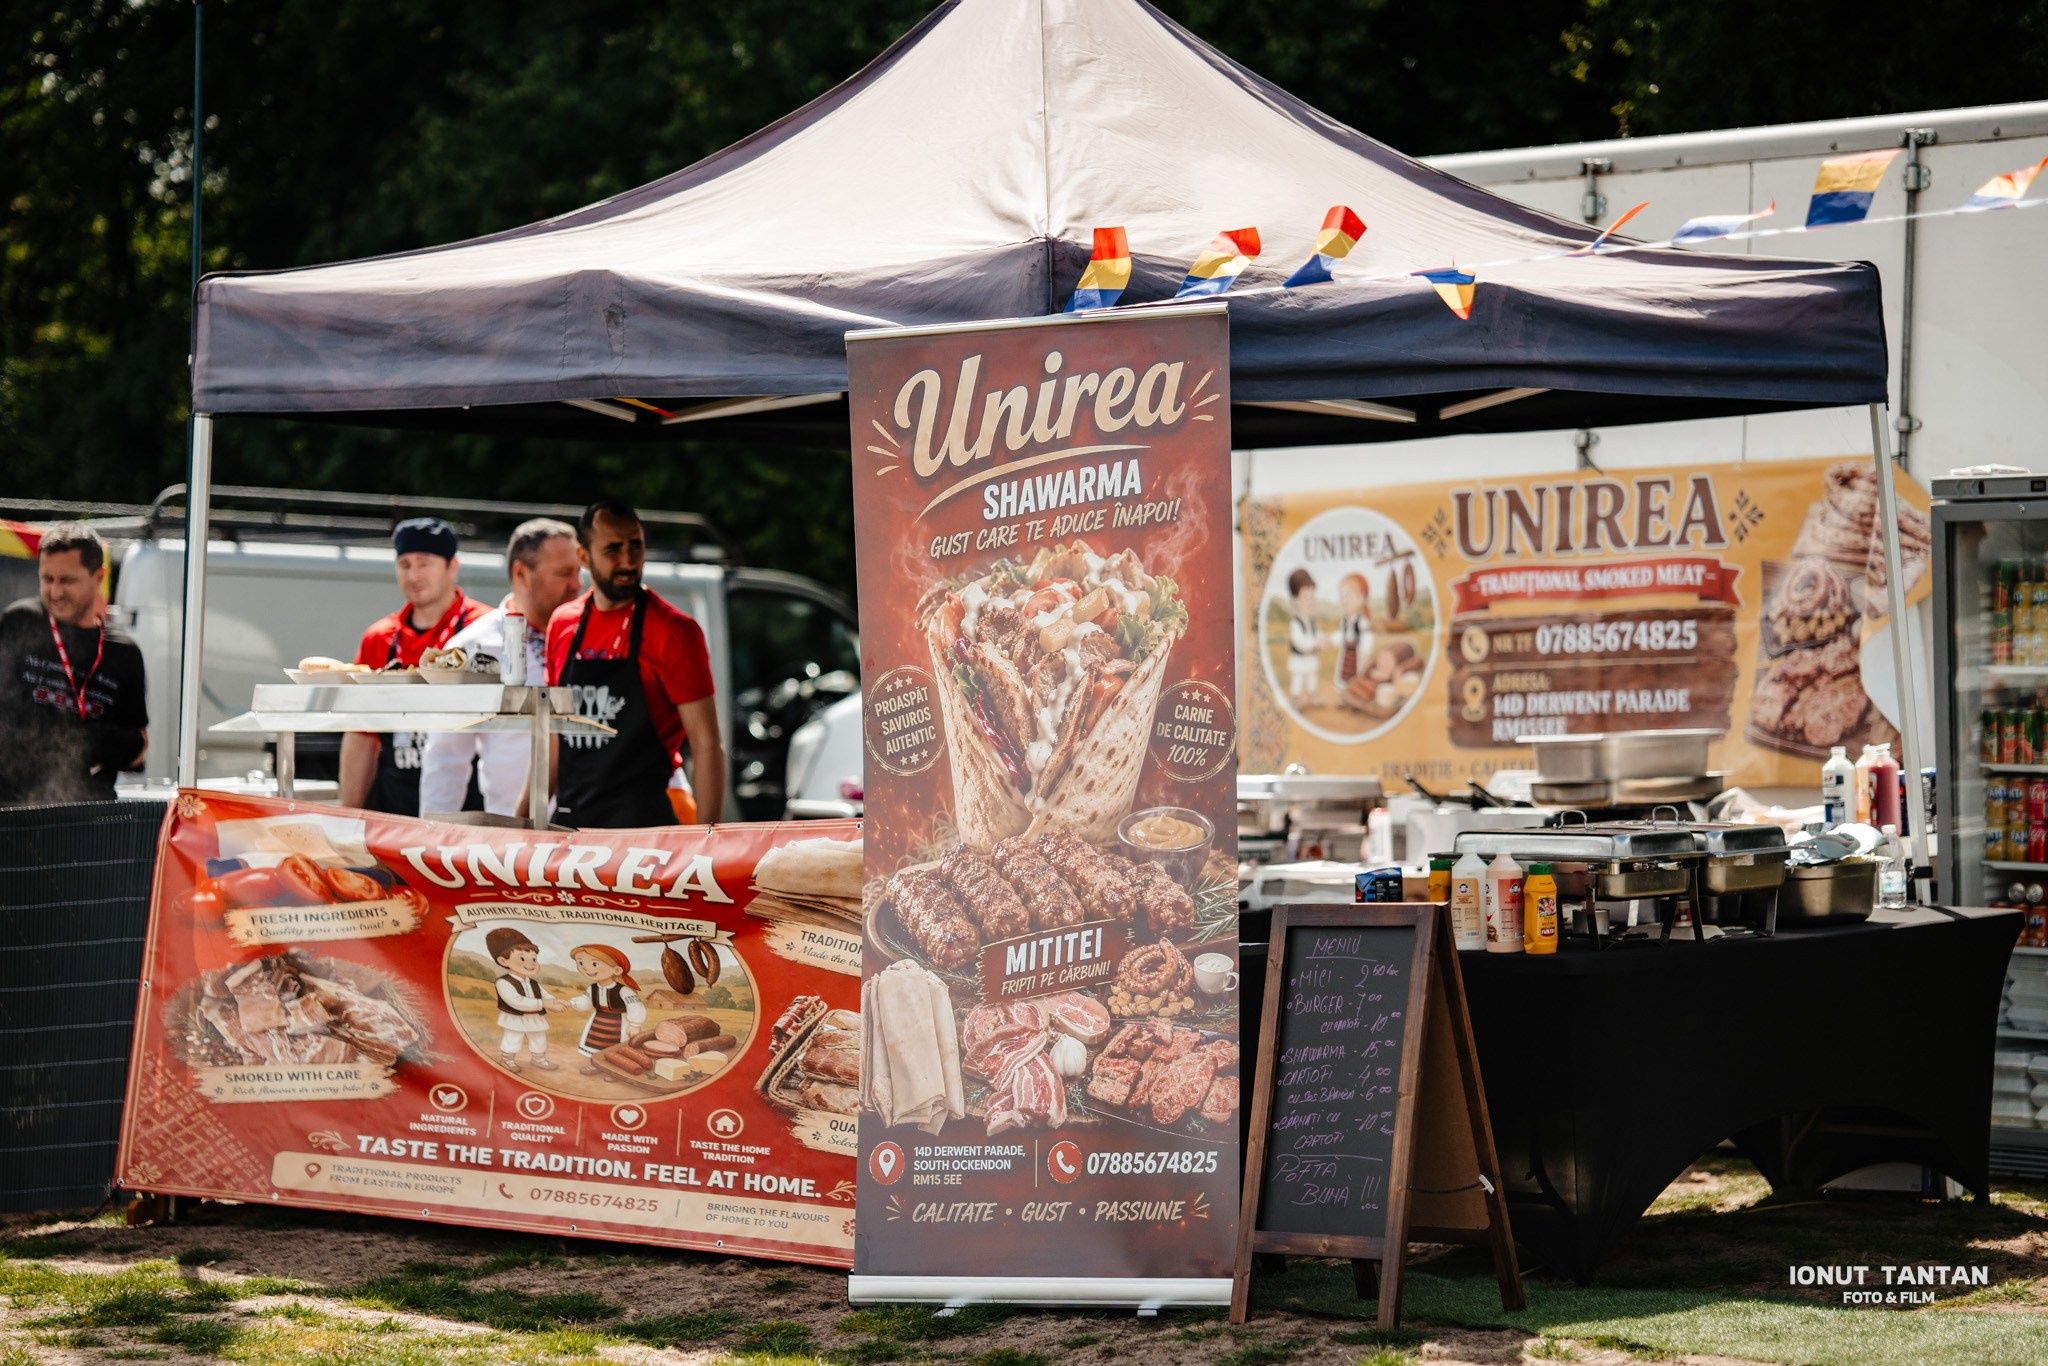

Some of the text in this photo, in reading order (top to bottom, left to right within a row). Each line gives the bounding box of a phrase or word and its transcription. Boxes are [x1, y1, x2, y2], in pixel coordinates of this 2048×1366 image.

[894, 352, 1186, 477] Unirea
[983, 459, 1142, 520] SHAWARMA
[1454, 477, 1726, 558] UNIREA
[930, 498, 1182, 559] GUST CARE TE ADUCE ÎNAPOI!
[1304, 533, 1397, 563] UNIREA
[1584, 566, 1654, 590] SMOKED
[1656, 564, 1706, 586] MEAT
[1536, 620, 1698, 654] 07885674825
[1493, 688, 1690, 716] 14D DERWENT PARADE
[882, 706, 931, 735] SAVUROS
[1174, 704, 1214, 724] CARNE
[886, 726, 936, 756] AUTENTIC
[1156, 722, 1226, 746] DE CALITATE
[1166, 744, 1208, 766] 100%
[401, 842, 734, 905] UNIREA
[250, 906, 388, 926] FRESH INGREDIENTS
[466, 906, 522, 918] AUTHENTIC
[558, 910, 637, 925] TRADITIONAL
[640, 918, 708, 934] HERITAGE.
[260, 926, 304, 938] Quality
[306, 926, 332, 936] you
[336, 924, 356, 932] can
[798, 945, 828, 960] Made
[831, 954, 846, 965] the
[1006, 928, 1102, 976] MITITEI
[1313, 934, 1362, 956] MENIU
[1040, 972, 1056, 988] PE
[1294, 994, 1344, 1015] BURGER
[1285, 1044, 1346, 1064] SHAWARMA
[225, 1070, 362, 1083] SMOKED WITH CARE
[1282, 1065, 1333, 1086] CARTOFI
[420, 1113, 468, 1126] NATURAL
[501, 1120, 566, 1135] TRADITIONAL
[1326, 1112, 1341, 1123] CU
[409, 1122, 477, 1136] INGREDIENTS
[510, 1132, 554, 1143] QUALITY
[602, 1132, 658, 1145] MADE WITH
[607, 1143, 650, 1154] PASSION
[690, 1140, 771, 1155] TASTE THE HOME
[914, 1145, 1026, 1157] 14D DERWENT PARADE,
[1294, 1132, 1345, 1150] CARTOFI
[357, 1135, 822, 1198] TASTE THE TRADITION. FEEL AT HOME.
[702, 1151, 755, 1164] TRADITION
[914, 1160, 1011, 1170] SOUTH OCKENDON
[1087, 1151, 1218, 1174] 07885674825
[329, 1174, 456, 1194] FROM EASTERN EUROPE
[331, 1164, 462, 1184] TRADITIONAL PRODUCTS
[914, 1174, 962, 1185] RM15 5EE
[530, 1188, 658, 1212] 07885674825
[707, 1202, 830, 1223] BRINGING THE FLAVOURS
[721, 1214, 750, 1225] HOME
[754, 1218, 765, 1226] TO
[768, 1220, 788, 1229] YOU
[912, 1200, 1186, 1223] CALITATE GUST PASSIUNE
